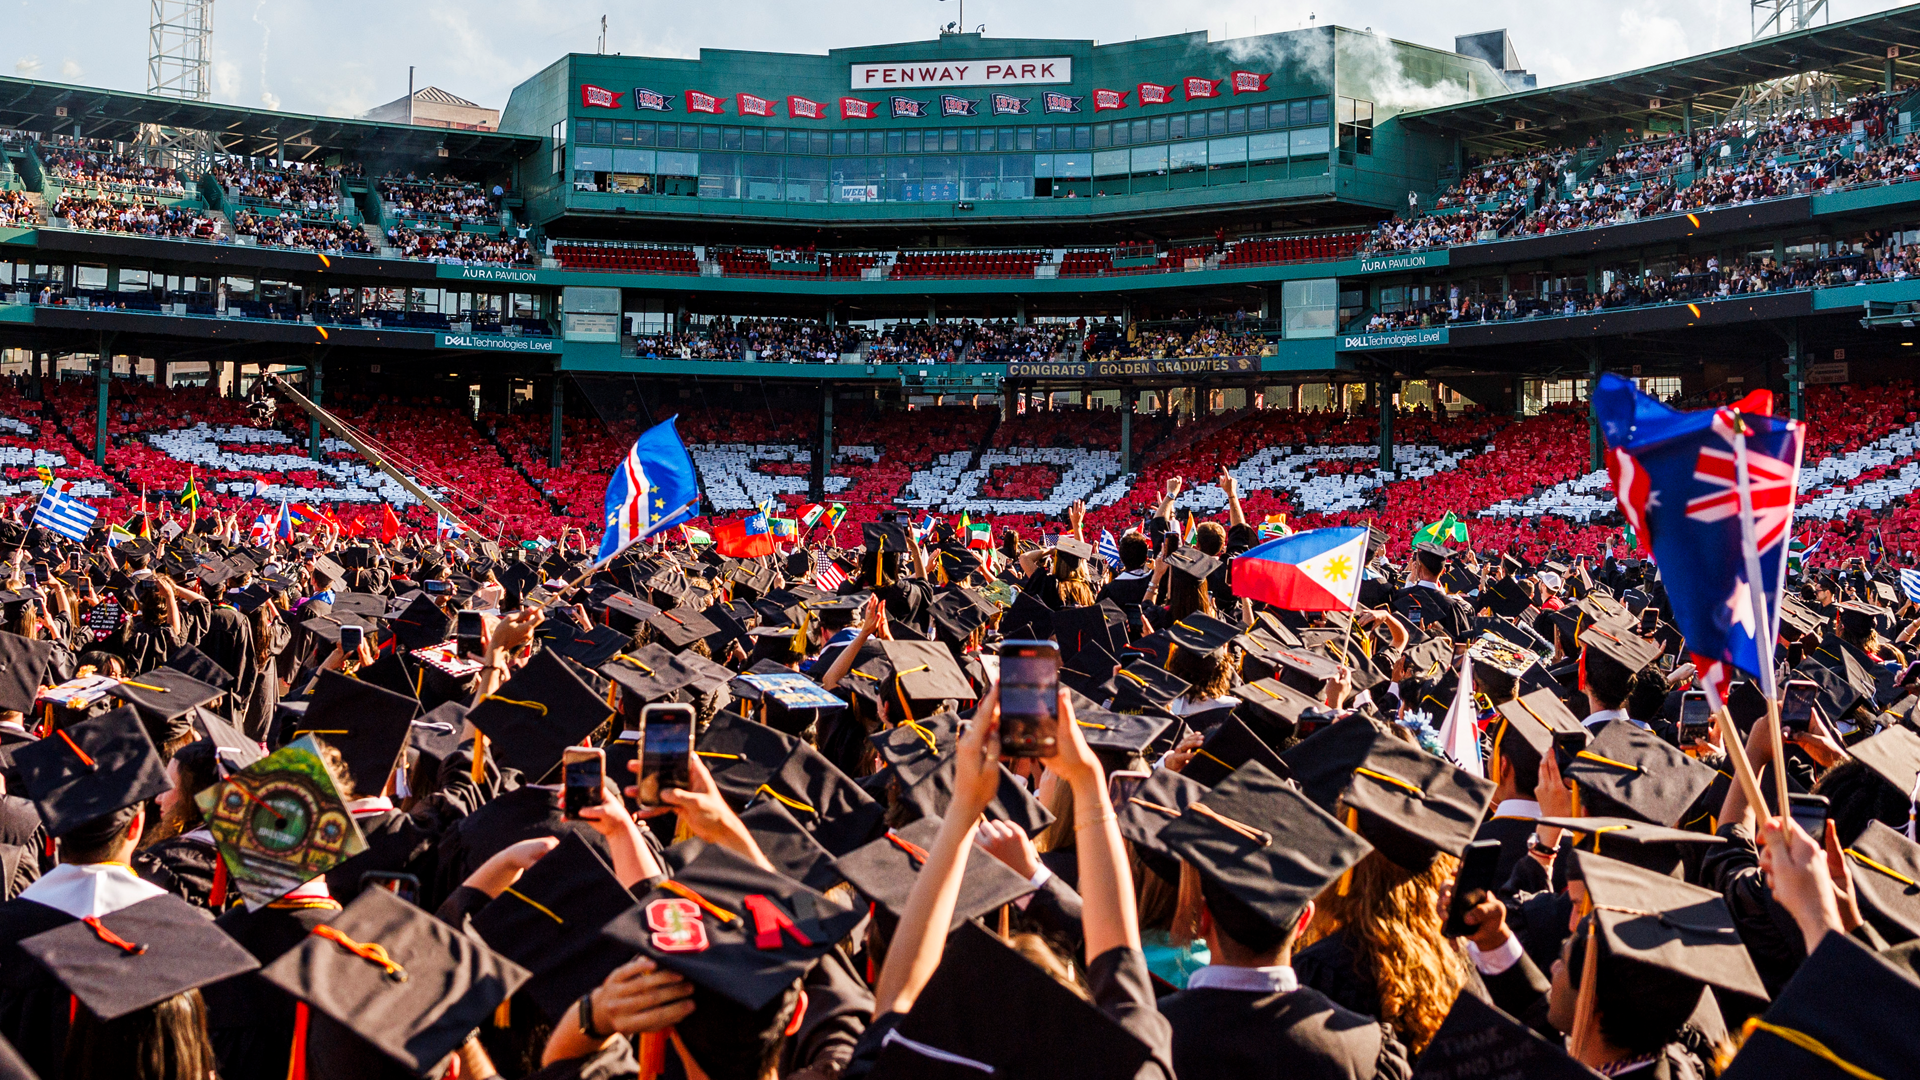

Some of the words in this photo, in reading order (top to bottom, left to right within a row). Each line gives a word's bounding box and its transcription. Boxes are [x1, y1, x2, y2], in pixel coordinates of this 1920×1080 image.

[865, 66, 969, 83] FENWAY
[986, 63, 1055, 79] PARK
[1189, 82, 1212, 93] 2013
[1236, 77, 1260, 87] 2018
[587, 90, 612, 104] 1903
[1097, 94, 1119, 105] 2004
[1142, 88, 1165, 99] 2007
[692, 96, 715, 109] 1912
[744, 99, 766, 112] 1915
[895, 101, 919, 113] 1946
[945, 100, 969, 112] 1967
[996, 98, 1020, 110] 1975
[1389, 256, 1426, 268] PAVILION
[495, 271, 536, 281] PAVILION
[445, 336, 472, 346] DELL
[472, 337, 528, 350] Technologies
[530, 340, 552, 350] Level
[1345, 337, 1368, 347] DELL
[1368, 334, 1417, 346] Technologies
[1419, 331, 1440, 342] Level
[1010, 364, 1086, 376] CONGRATS
[1100, 363, 1150, 375] GOLDEN
[1156, 359, 1229, 373] GRADUATES
